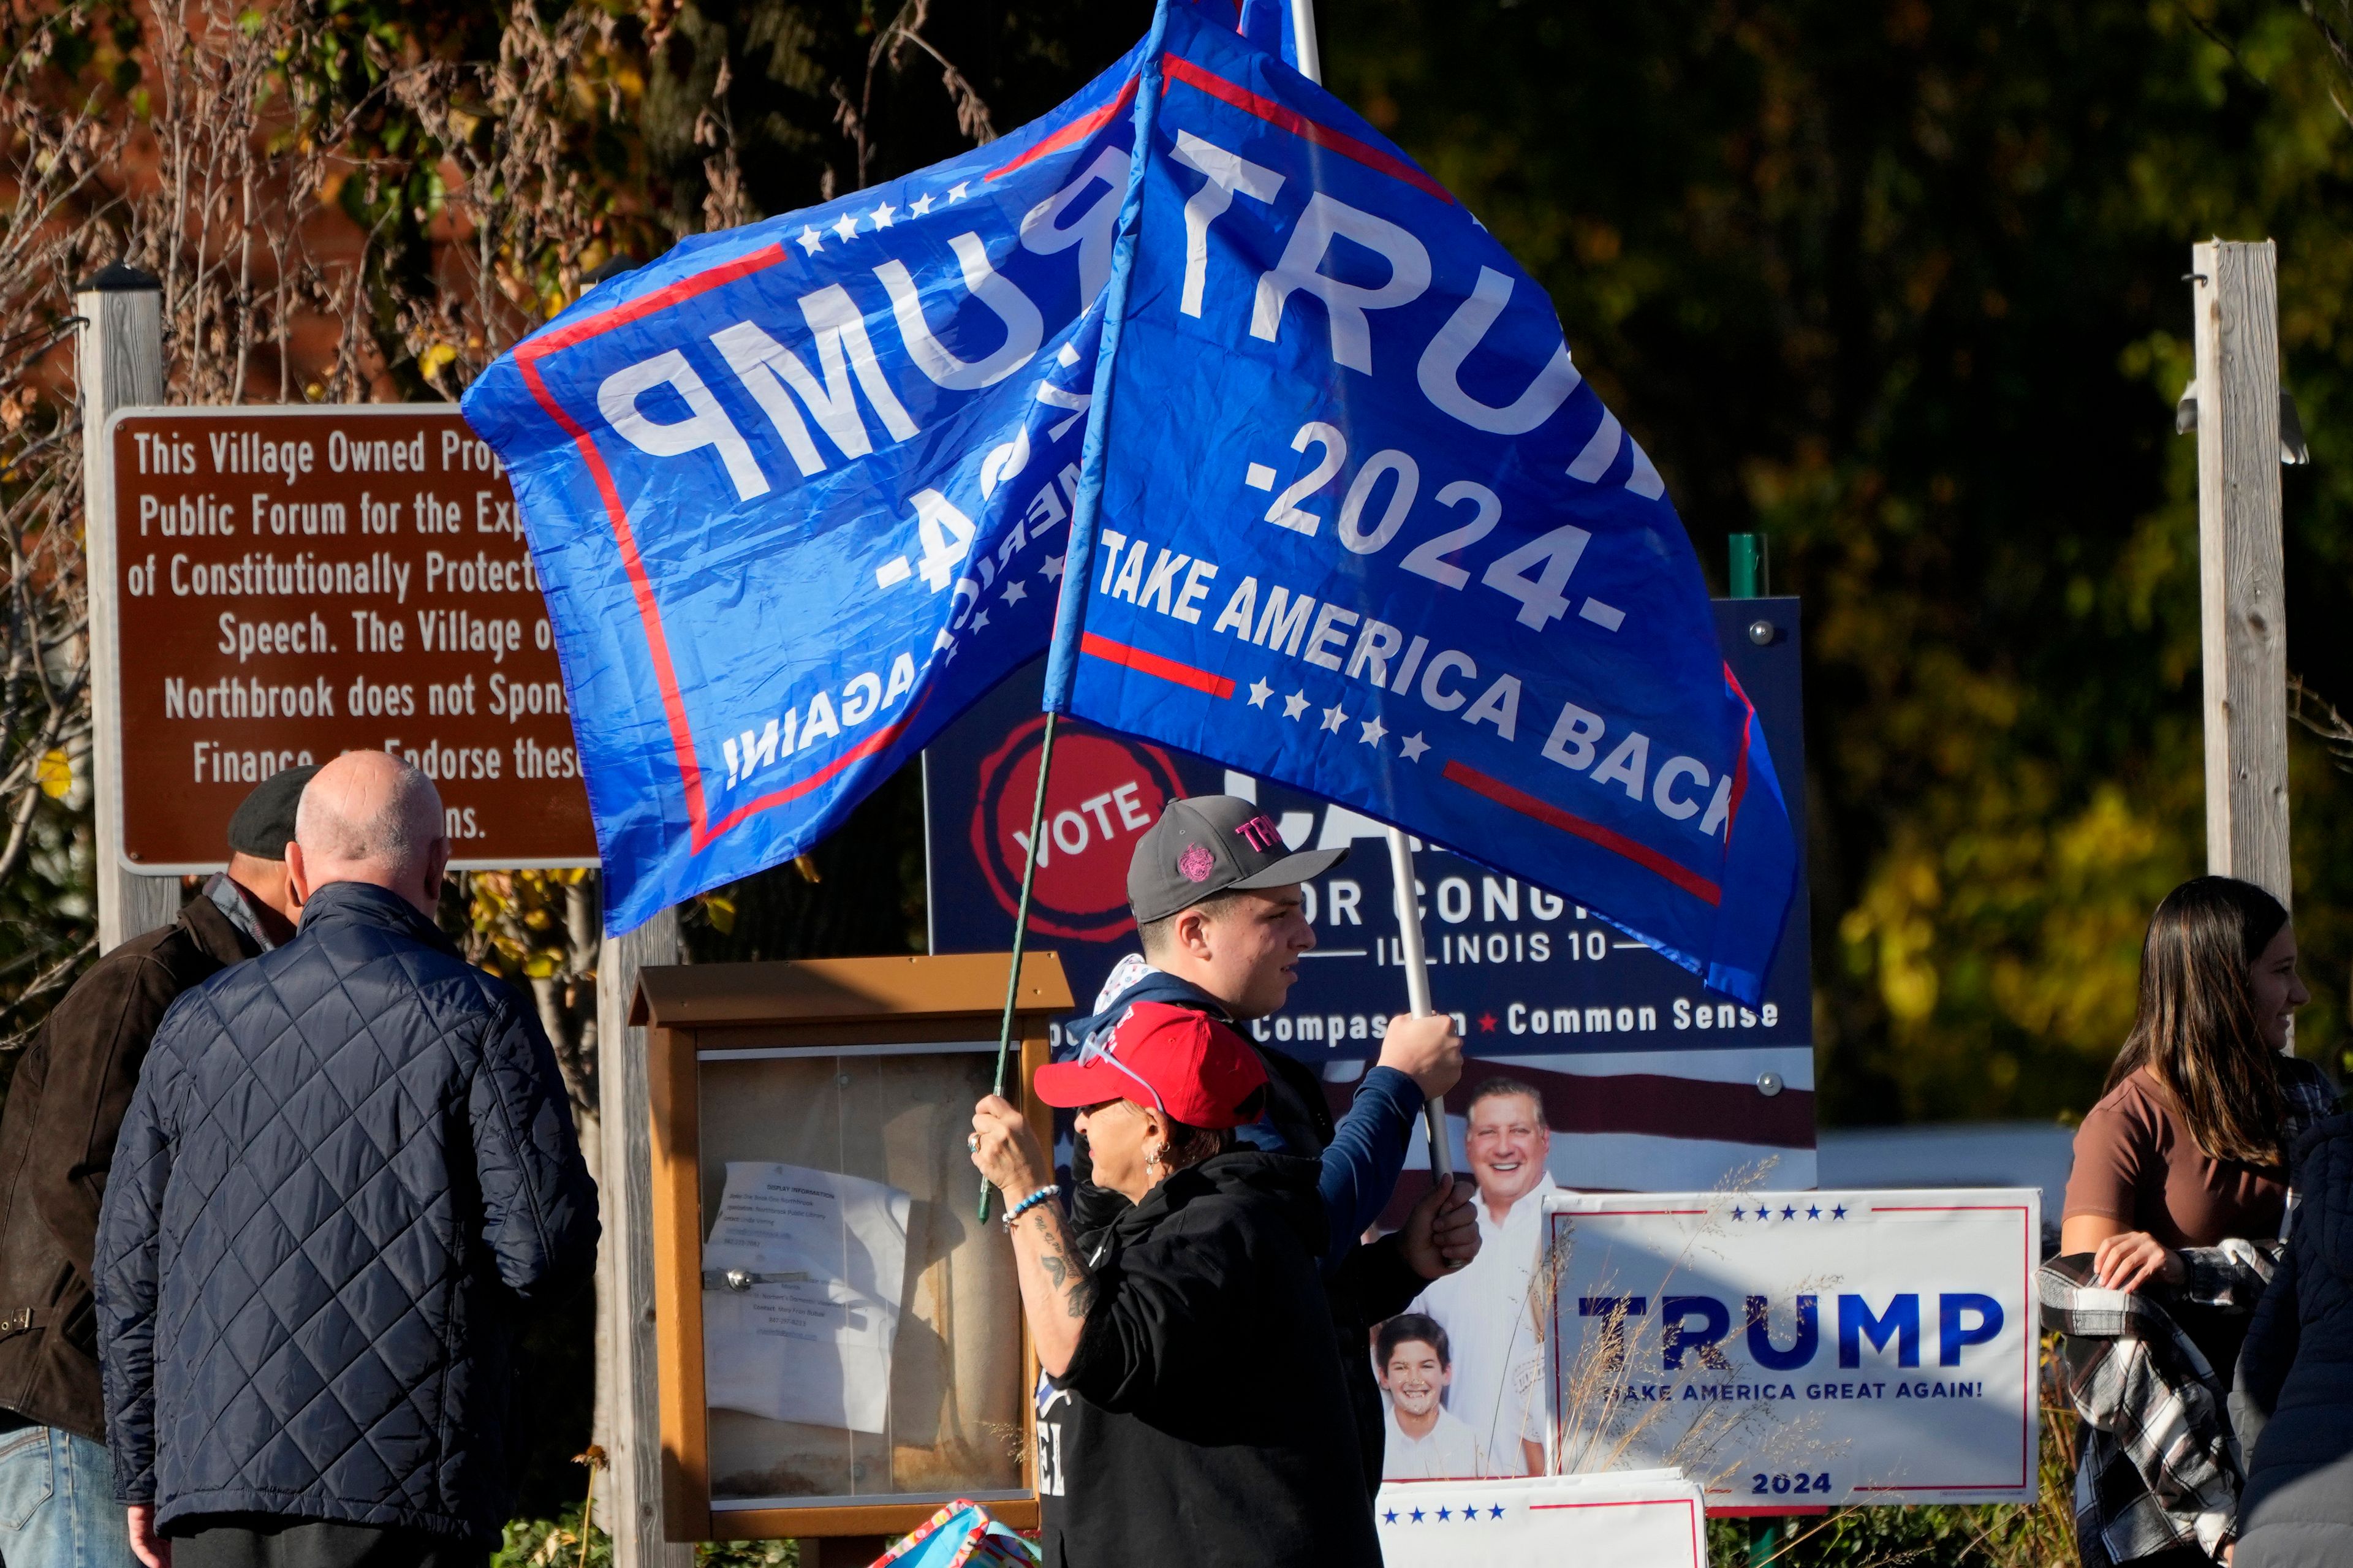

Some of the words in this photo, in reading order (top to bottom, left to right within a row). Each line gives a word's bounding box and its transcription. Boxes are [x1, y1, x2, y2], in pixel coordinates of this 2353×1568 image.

[134, 431, 197, 475] This
[209, 430, 314, 487] Village
[328, 430, 426, 474] Owned
[140, 493, 235, 537] Public
[252, 492, 347, 536] Forum
[360, 491, 402, 535] for
[413, 491, 461, 534] the
[1246, 421, 1627, 633] -2024-
[127, 554, 157, 597] of
[170, 551, 411, 605] Constitutionally
[218, 611, 338, 664] Speech.
[352, 610, 404, 653] The
[417, 608, 521, 664] Village
[534, 618, 557, 651] o
[1100, 528, 1219, 625] TAKE
[1212, 575, 1522, 743] AMERICA
[164, 675, 335, 719] Northbrook
[347, 674, 415, 718] does
[429, 674, 476, 716] not
[1013, 781, 1151, 869] VOTE
[1393, 876, 1587, 923] ONG
[1567, 931, 1607, 961] 10
[1251, 1011, 1467, 1048] Compasn
[1507, 1002, 1657, 1036] Common
[1673, 997, 1778, 1032] Sense
[1578, 1293, 2004, 1371] TRUMP
[1682, 1383, 1797, 1403] AMERICA
[1806, 1382, 1886, 1400] GREAT
[1896, 1381, 1983, 1399] AGAIN!
[1751, 1472, 1832, 1495] 2024
